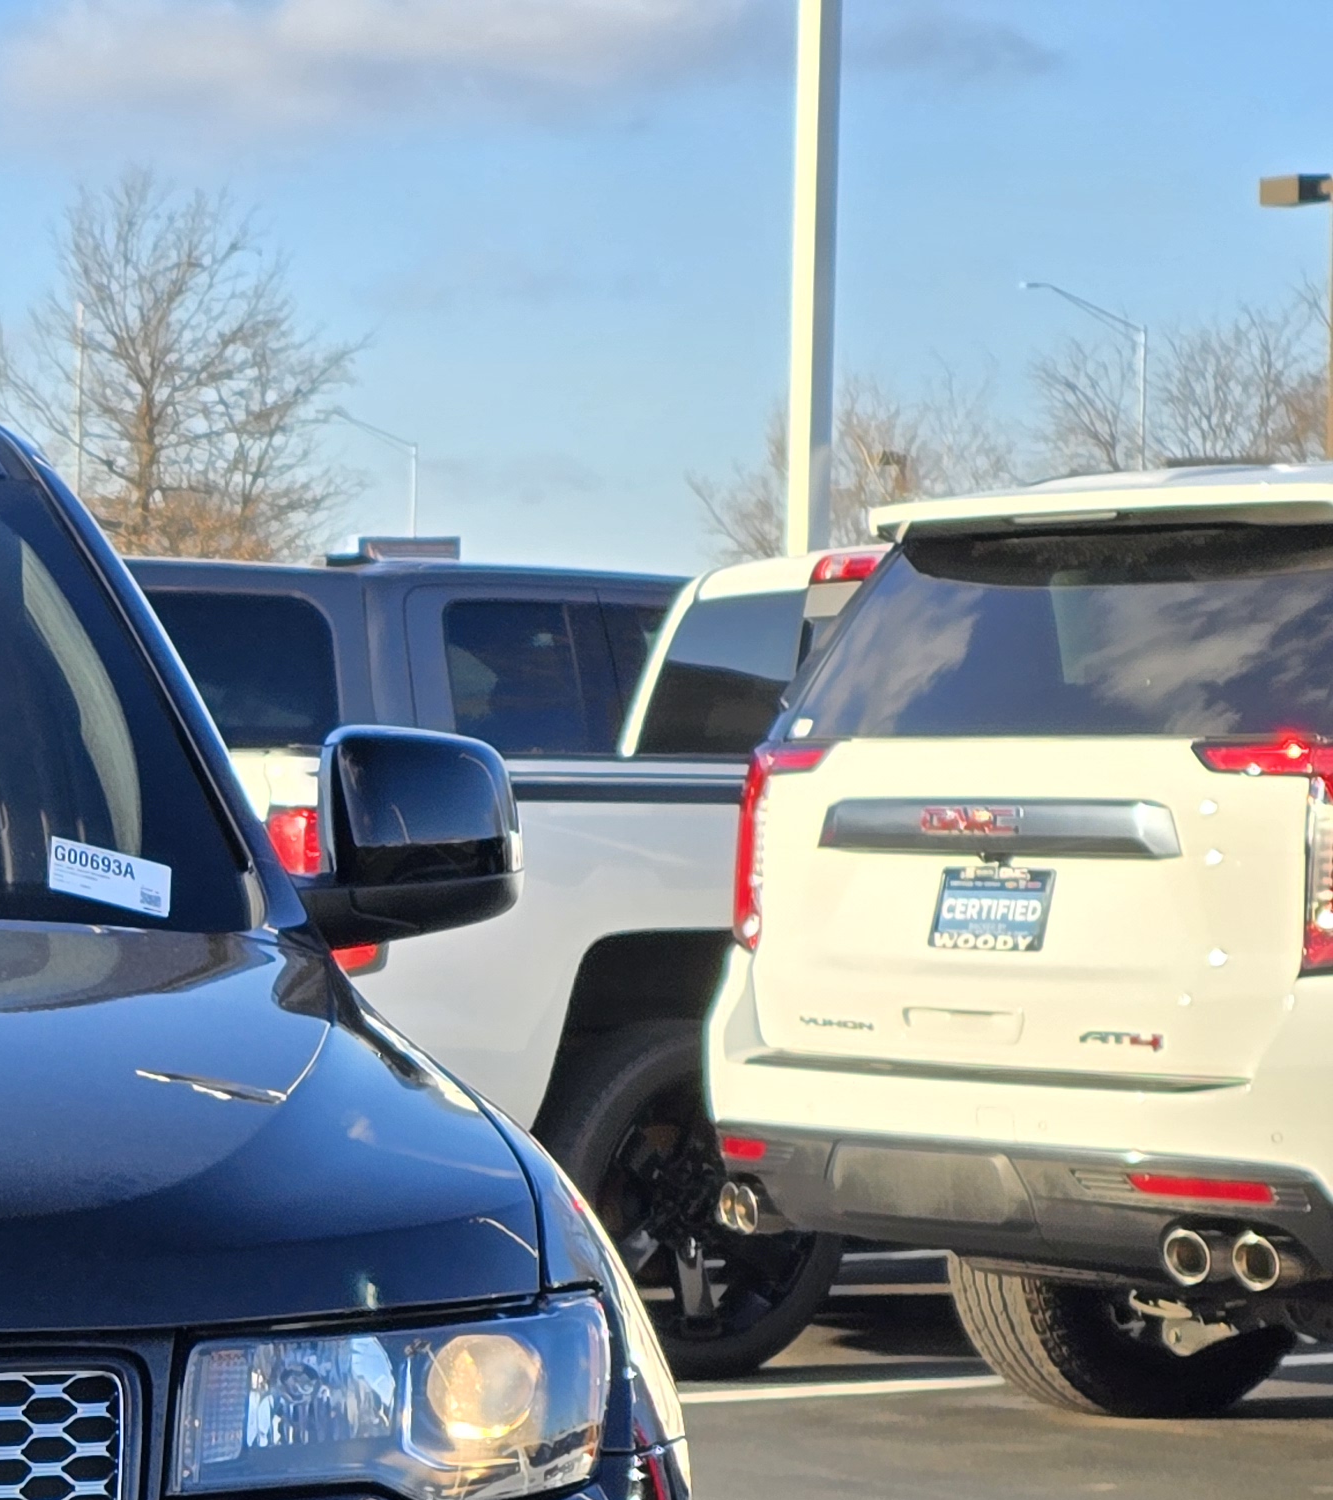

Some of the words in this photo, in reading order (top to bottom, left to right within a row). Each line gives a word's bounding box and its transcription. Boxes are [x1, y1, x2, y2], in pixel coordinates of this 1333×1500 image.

[920, 805, 1024, 836] GMC
[54, 845, 136, 881] G00693A
[941, 897, 1042, 922] CERTIFIED
[933, 932, 1033, 950] WOODY
[799, 1015, 874, 1031] YUKON
[1079, 1031, 1163, 1052] AT4
